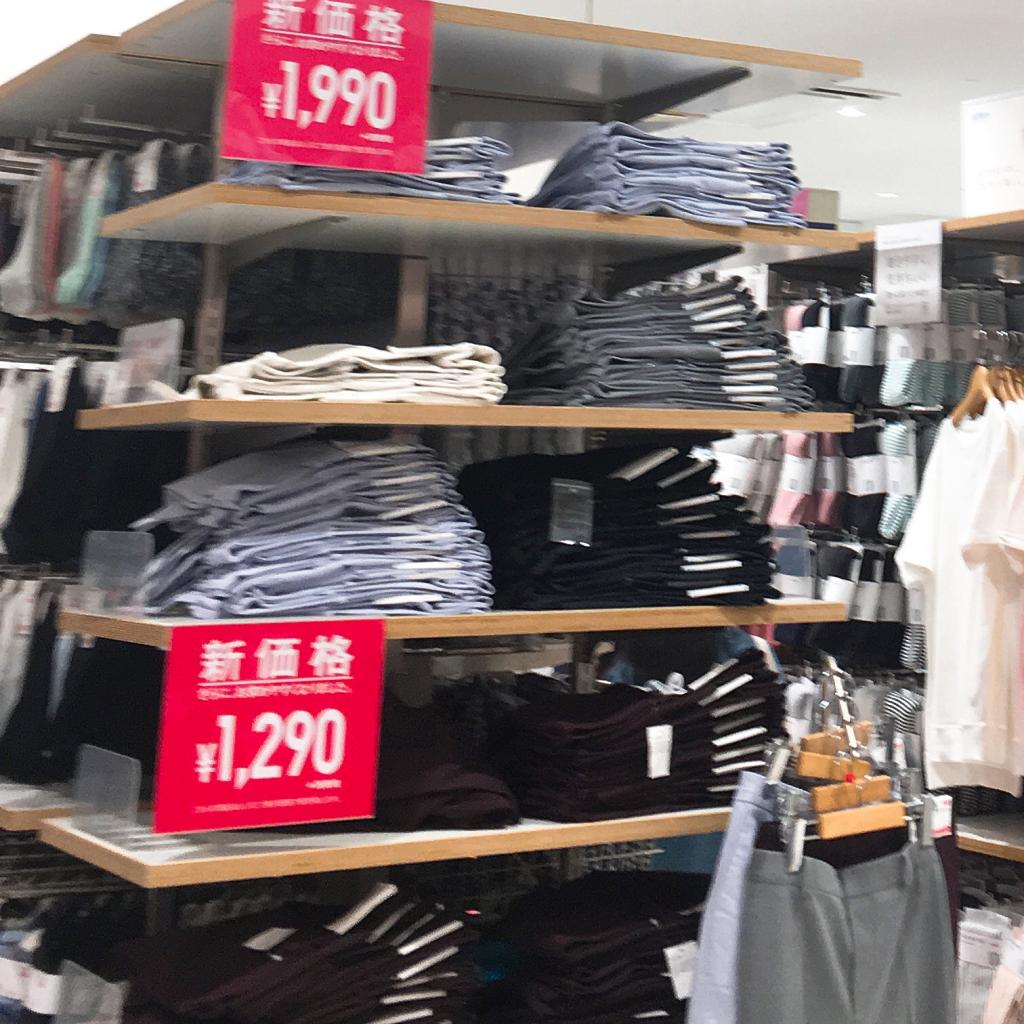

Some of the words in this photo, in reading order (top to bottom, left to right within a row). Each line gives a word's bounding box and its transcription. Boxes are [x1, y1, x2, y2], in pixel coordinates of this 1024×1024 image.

[261, 60, 397, 130] ¥1,990
[198, 635, 355, 682] 新価格
[195, 708, 348, 790] ¥1,290
